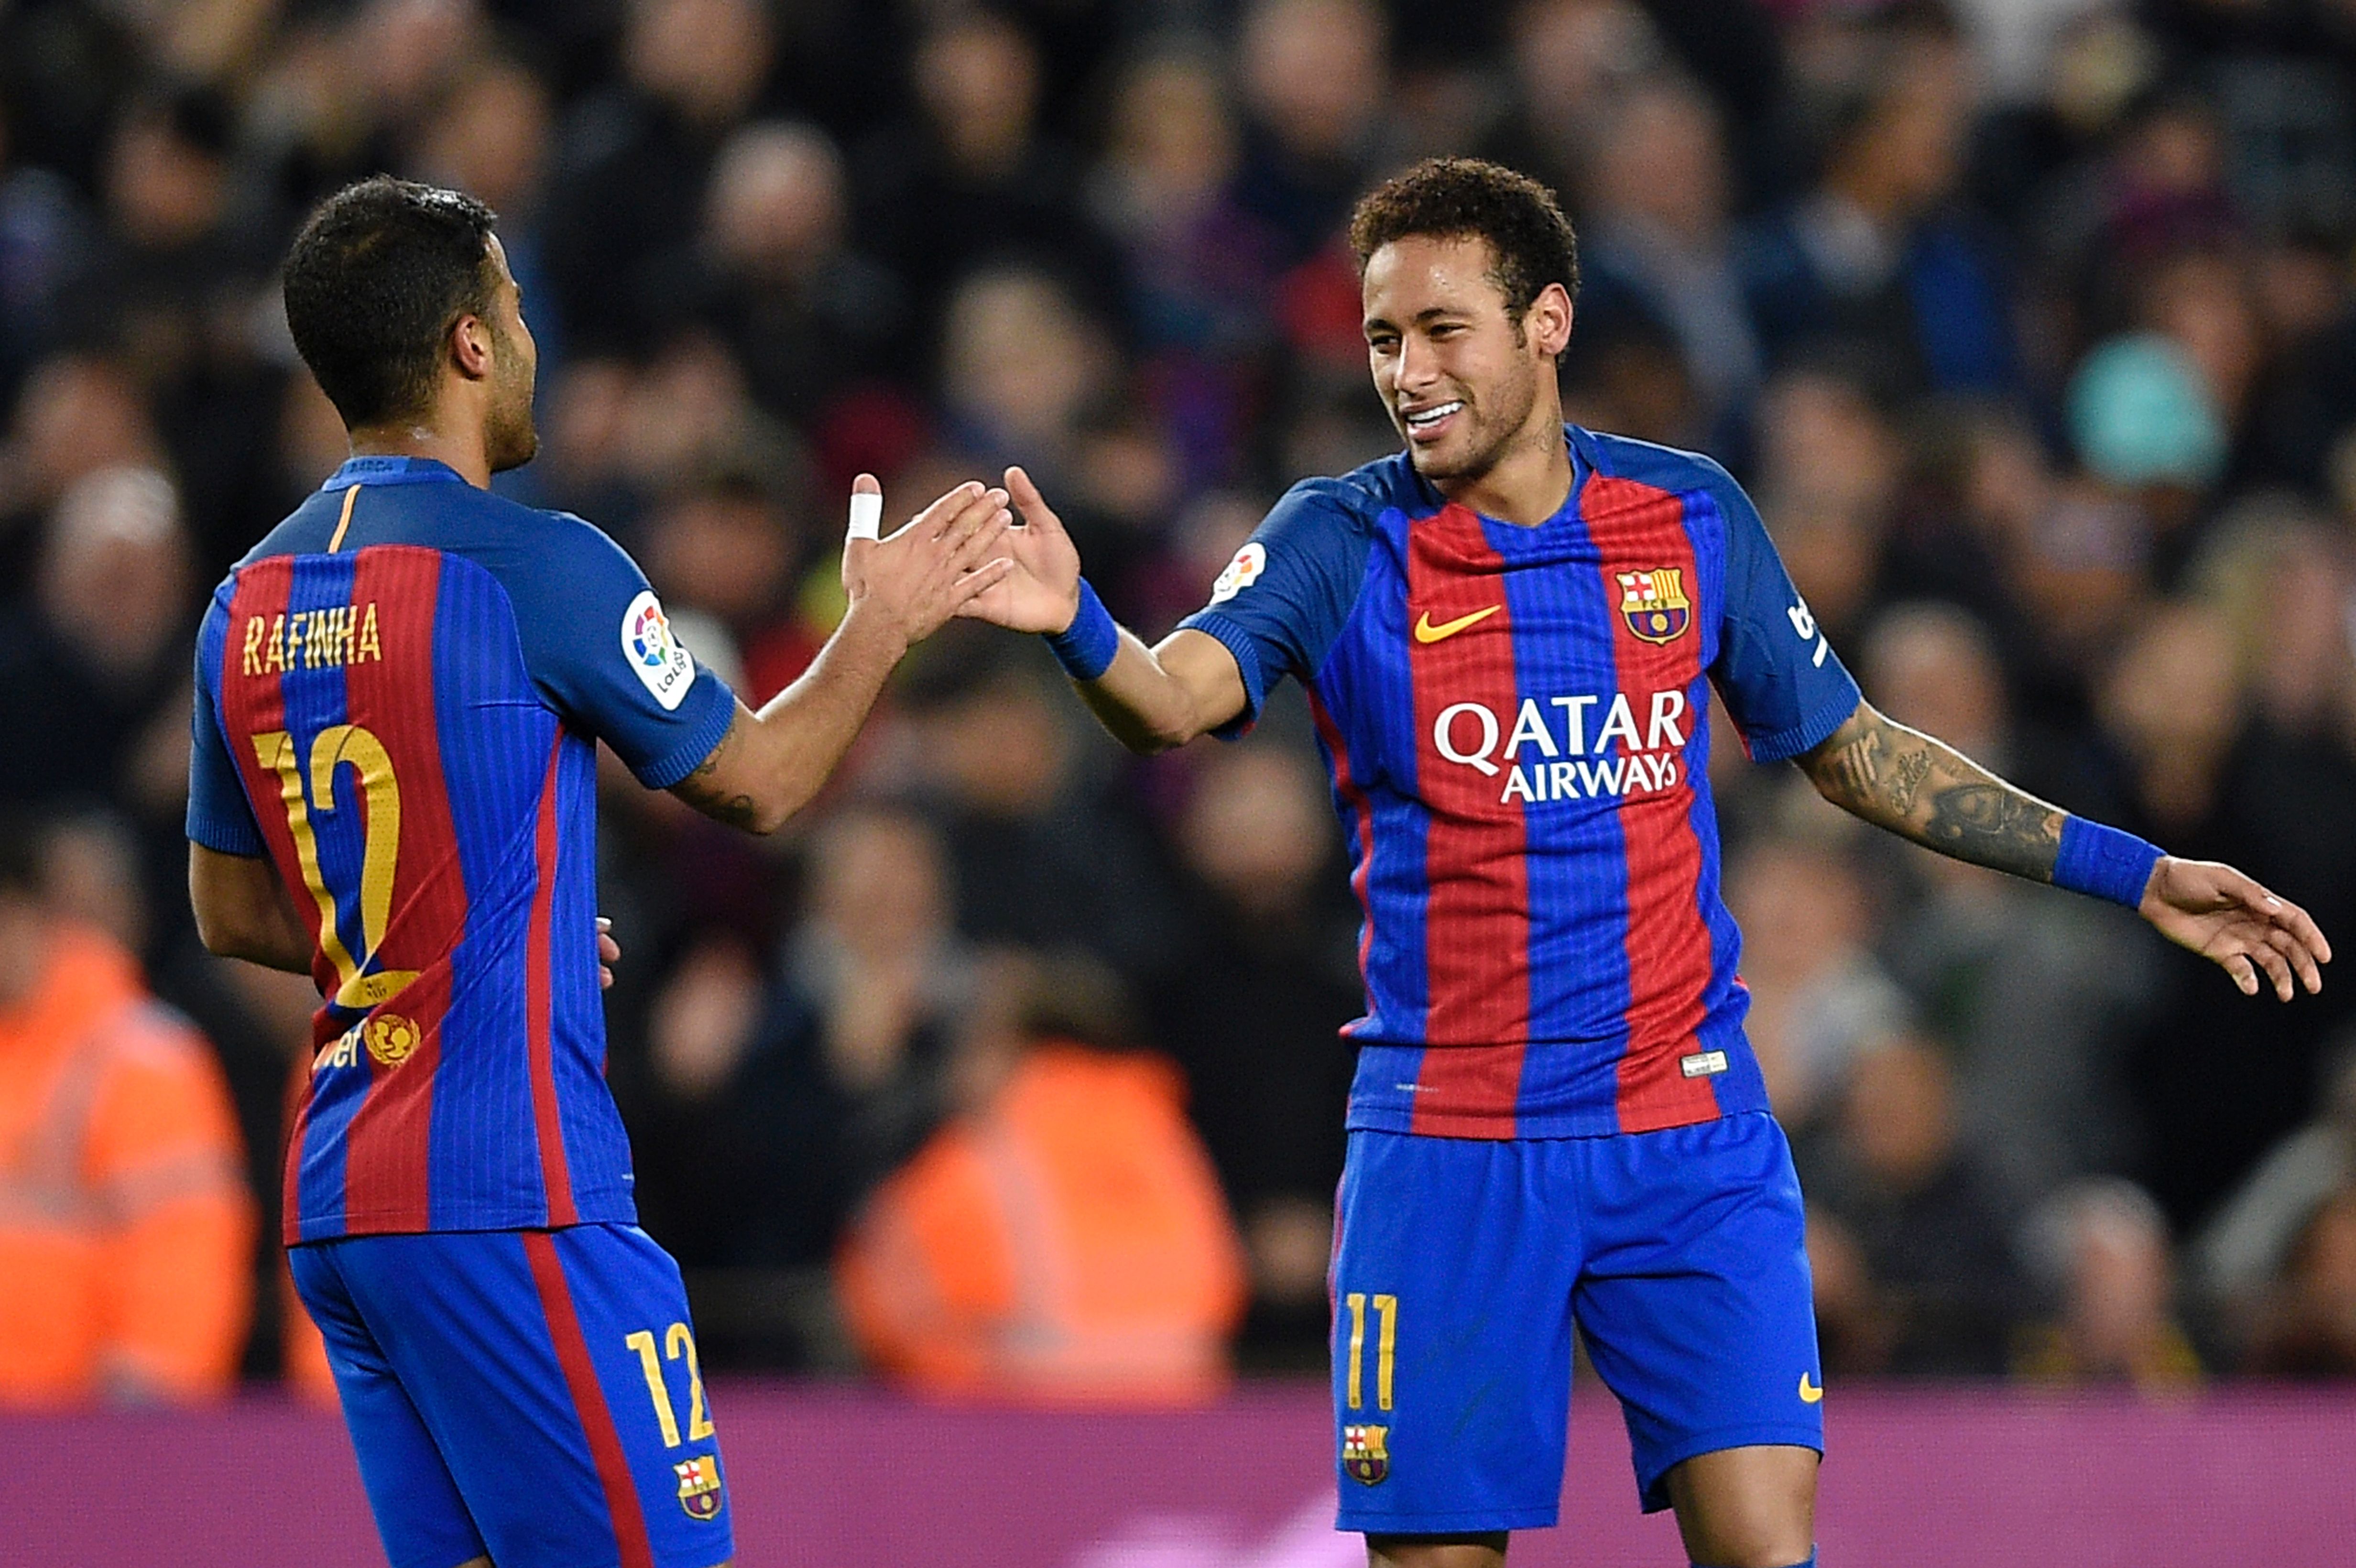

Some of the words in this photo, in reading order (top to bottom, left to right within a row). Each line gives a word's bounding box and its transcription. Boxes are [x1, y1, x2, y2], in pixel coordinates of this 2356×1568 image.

[243, 603, 382, 675] RAFINHA
[1434, 690, 1686, 776] QATAR
[1500, 752, 1677, 803] AIRWAYS
[251, 724, 421, 1008] 12
[626, 1322, 715, 1448] 12
[1347, 1293, 1397, 1411] 11
